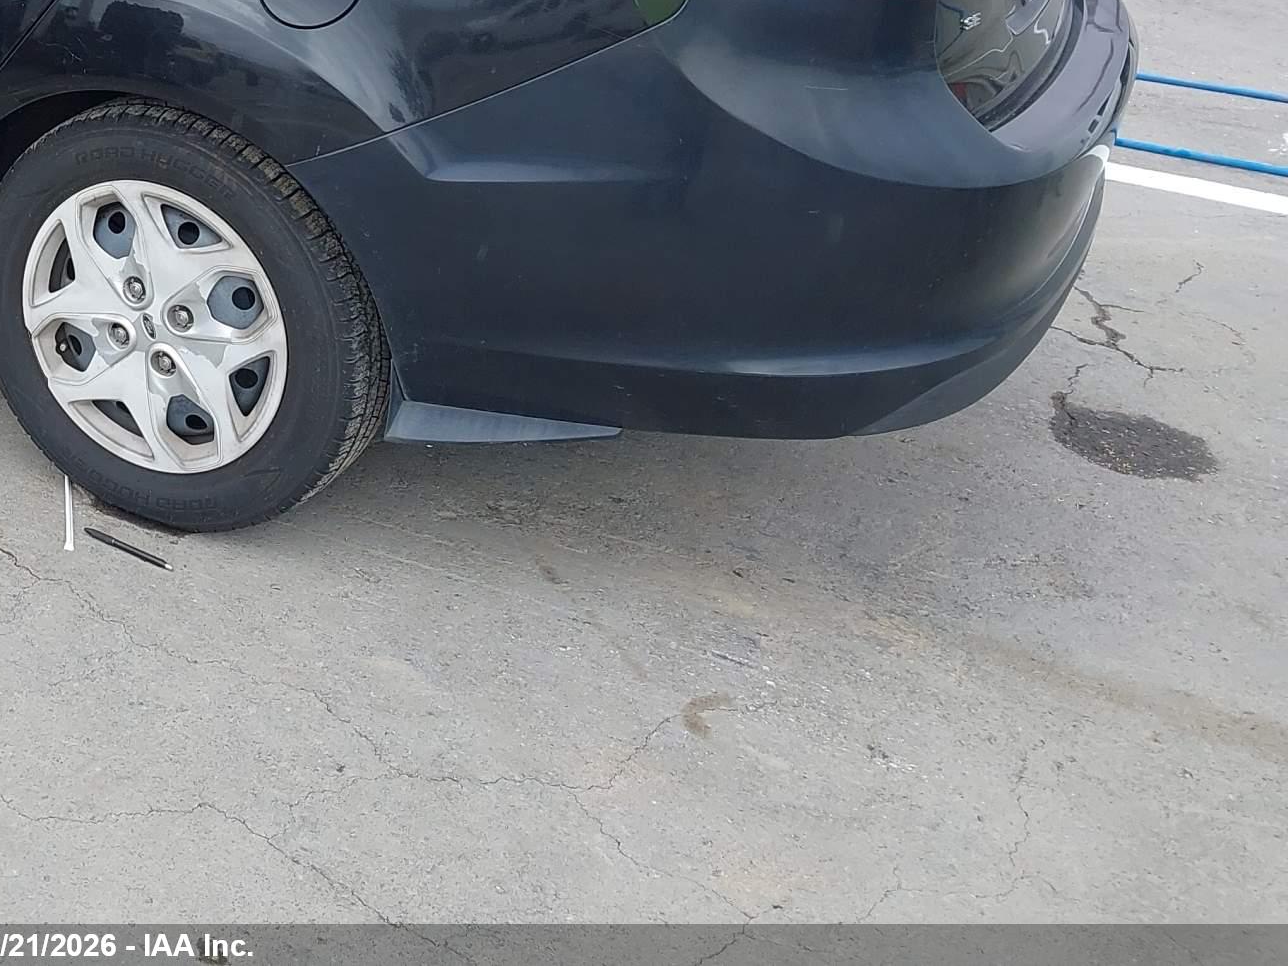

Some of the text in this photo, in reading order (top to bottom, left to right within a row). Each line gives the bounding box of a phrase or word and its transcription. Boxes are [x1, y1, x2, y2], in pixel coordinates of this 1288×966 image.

[960, 12, 982, 31] SE
[75, 146, 237, 200] ROAD HUGGER
